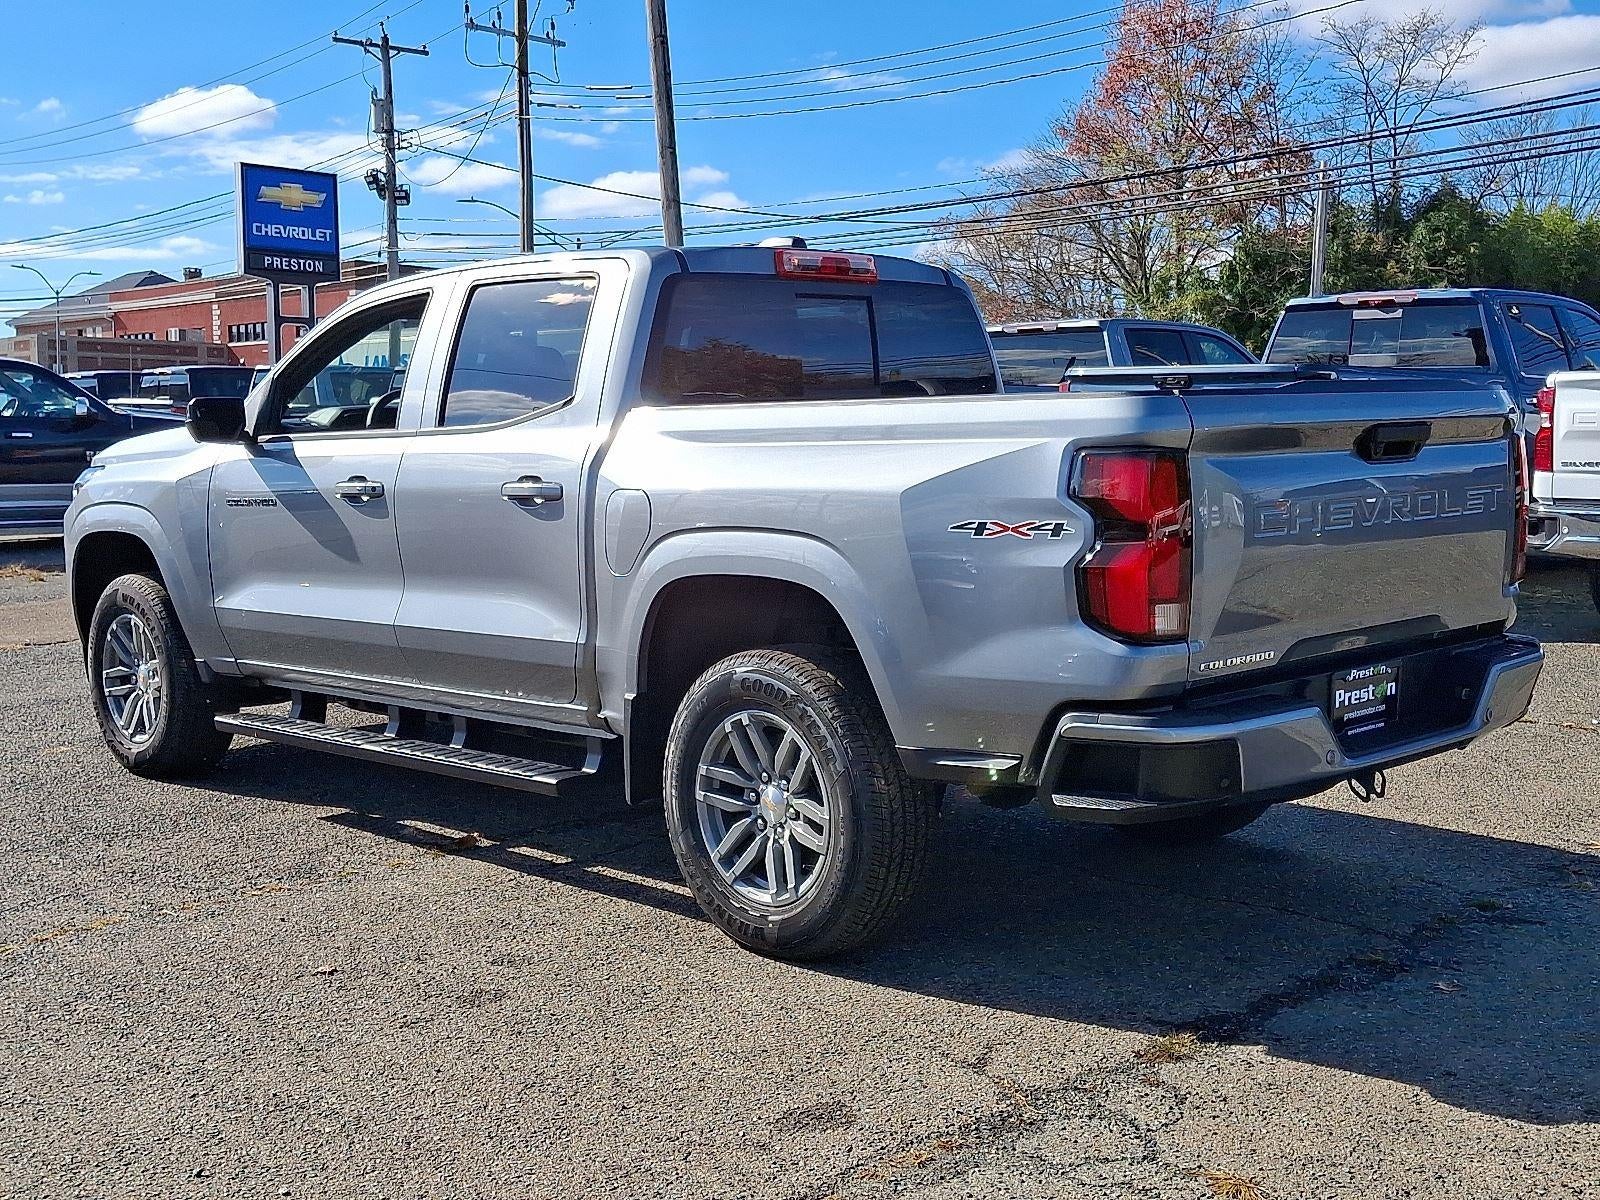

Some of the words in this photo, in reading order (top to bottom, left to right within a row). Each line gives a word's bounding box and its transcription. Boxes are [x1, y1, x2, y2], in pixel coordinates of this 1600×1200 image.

[252, 222, 333, 242] CHEVROLET
[264, 256, 323, 273] PRESTON
[1253, 484, 1503, 538] CHEVROLET
[1199, 650, 1275, 672] COLORADO
